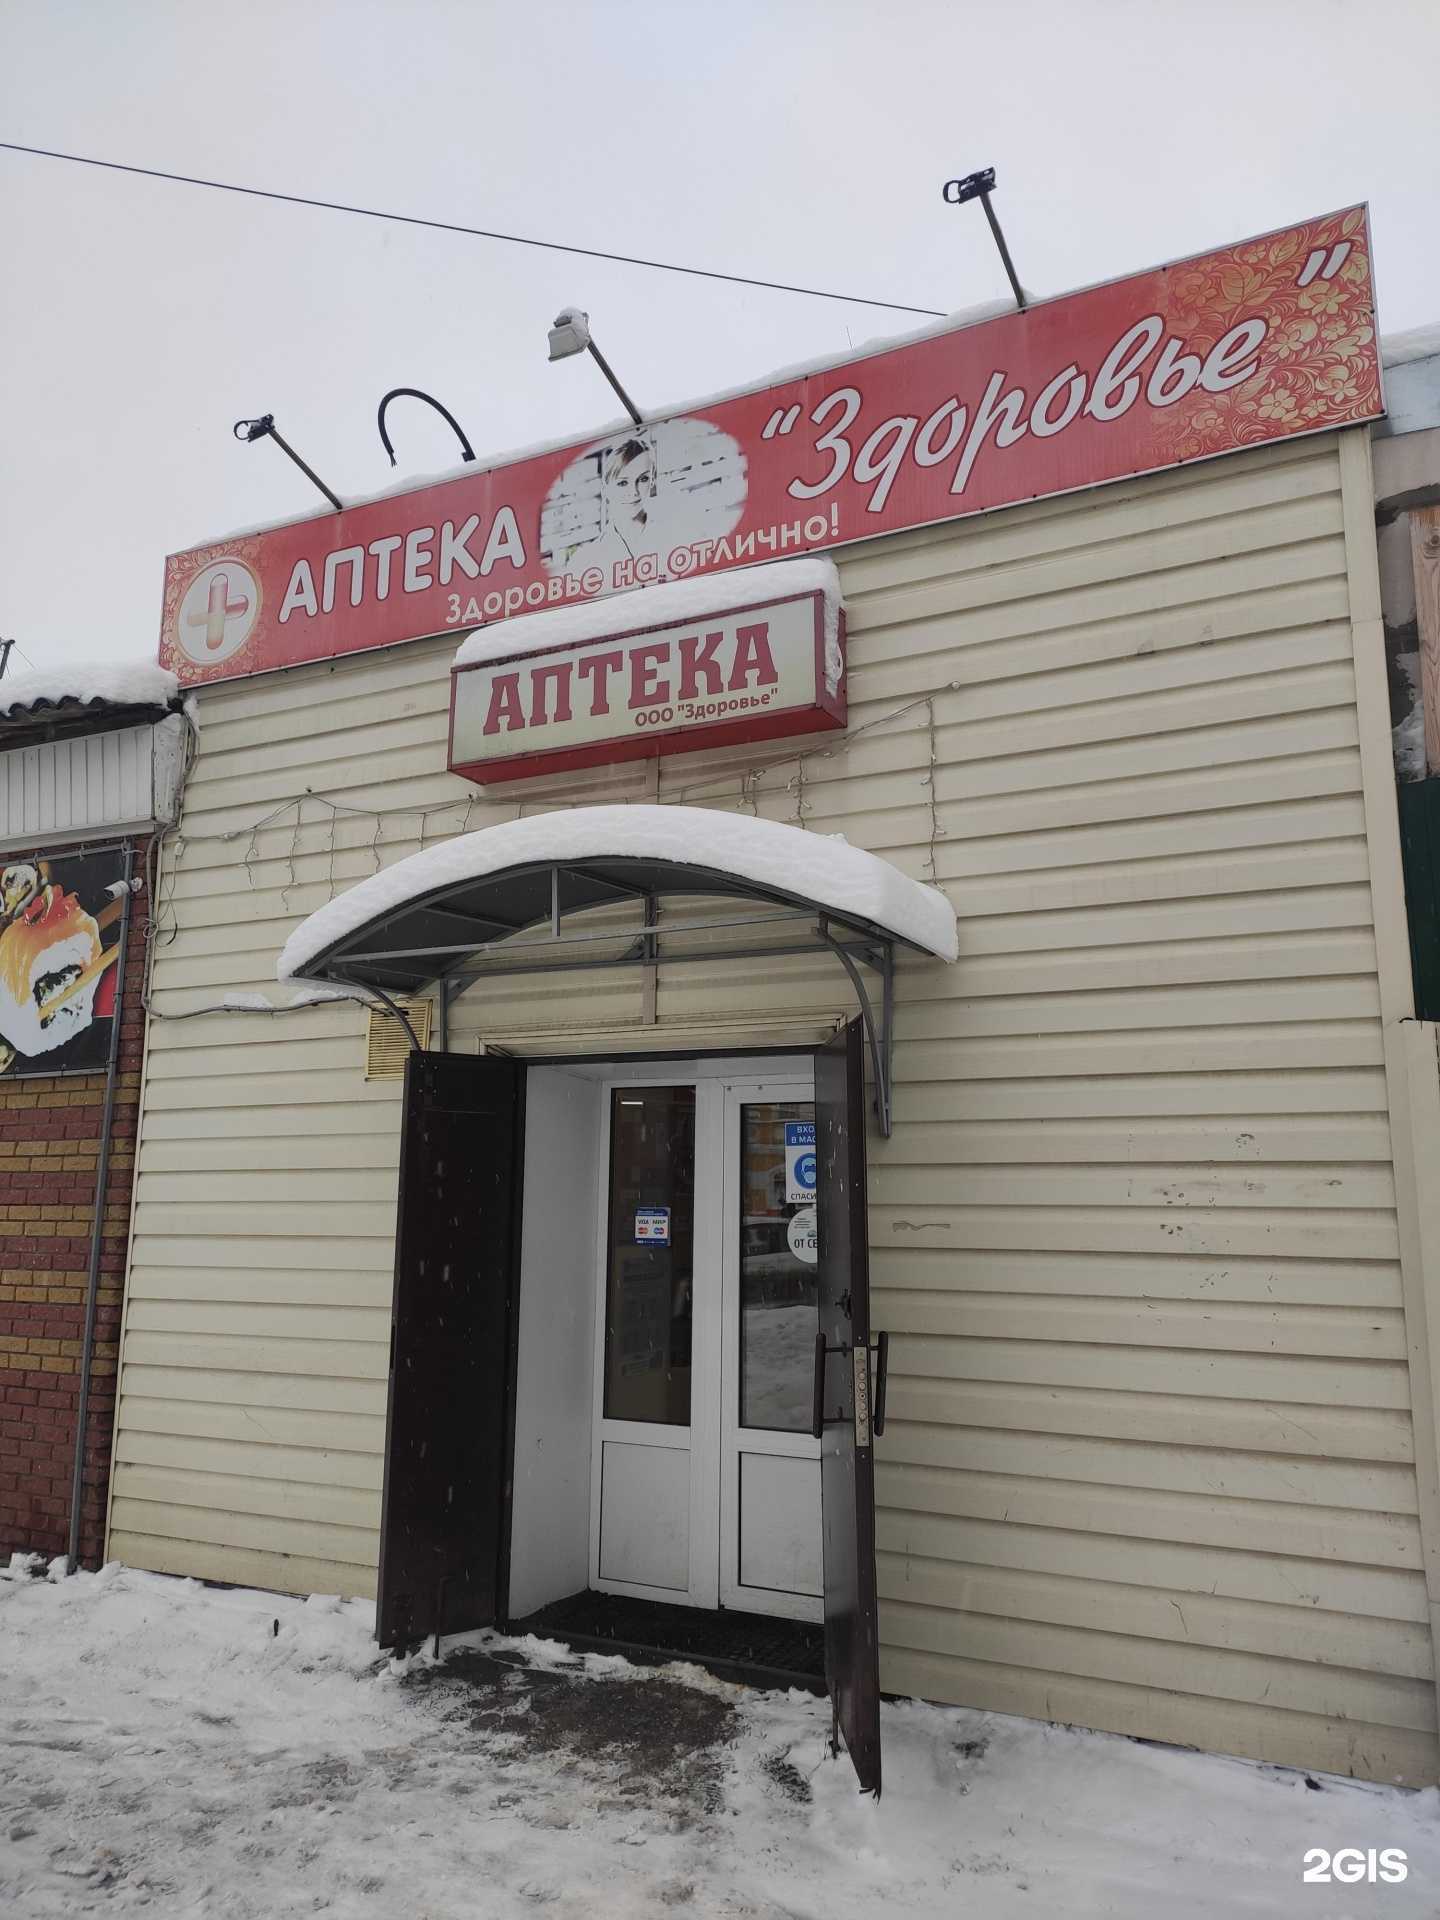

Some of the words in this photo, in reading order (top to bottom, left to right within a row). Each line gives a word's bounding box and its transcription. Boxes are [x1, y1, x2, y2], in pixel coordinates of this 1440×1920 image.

[278, 505, 526, 623] АПТЕКА
[613, 553, 659, 588] на
[483, 622, 778, 735] АПТЕКА
[634, 707, 674, 727] ООО
[677, 688, 779, 720] "Здоровье"
[794, 1238, 805, 1249] ОТ
